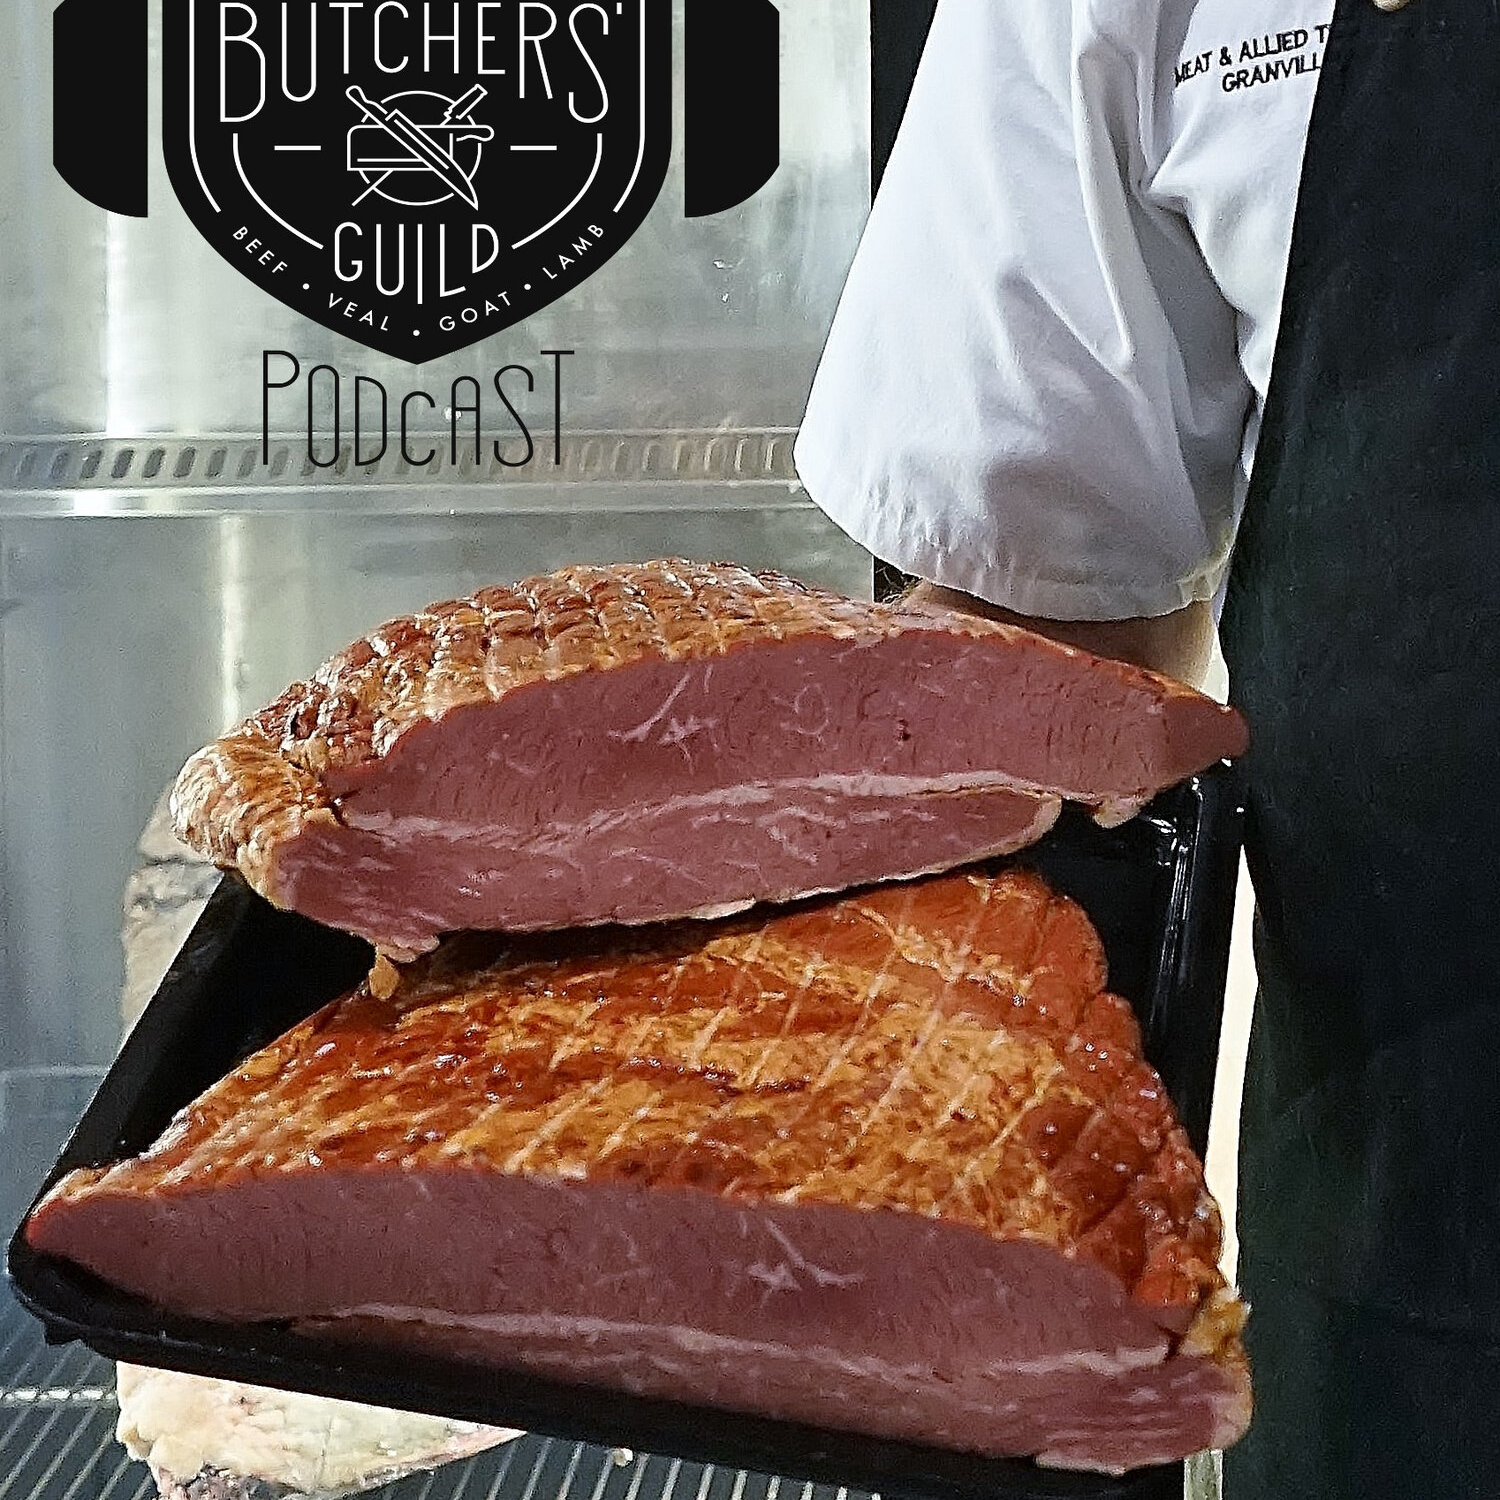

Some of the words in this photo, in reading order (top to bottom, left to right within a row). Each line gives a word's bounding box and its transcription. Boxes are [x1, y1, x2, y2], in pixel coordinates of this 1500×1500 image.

[1175, 50, 1212, 87] MEAT
[1219, 46, 1232, 67] &
[1239, 28, 1309, 63] ALLIED
[1221, 52, 1322, 93] GRANVILL
